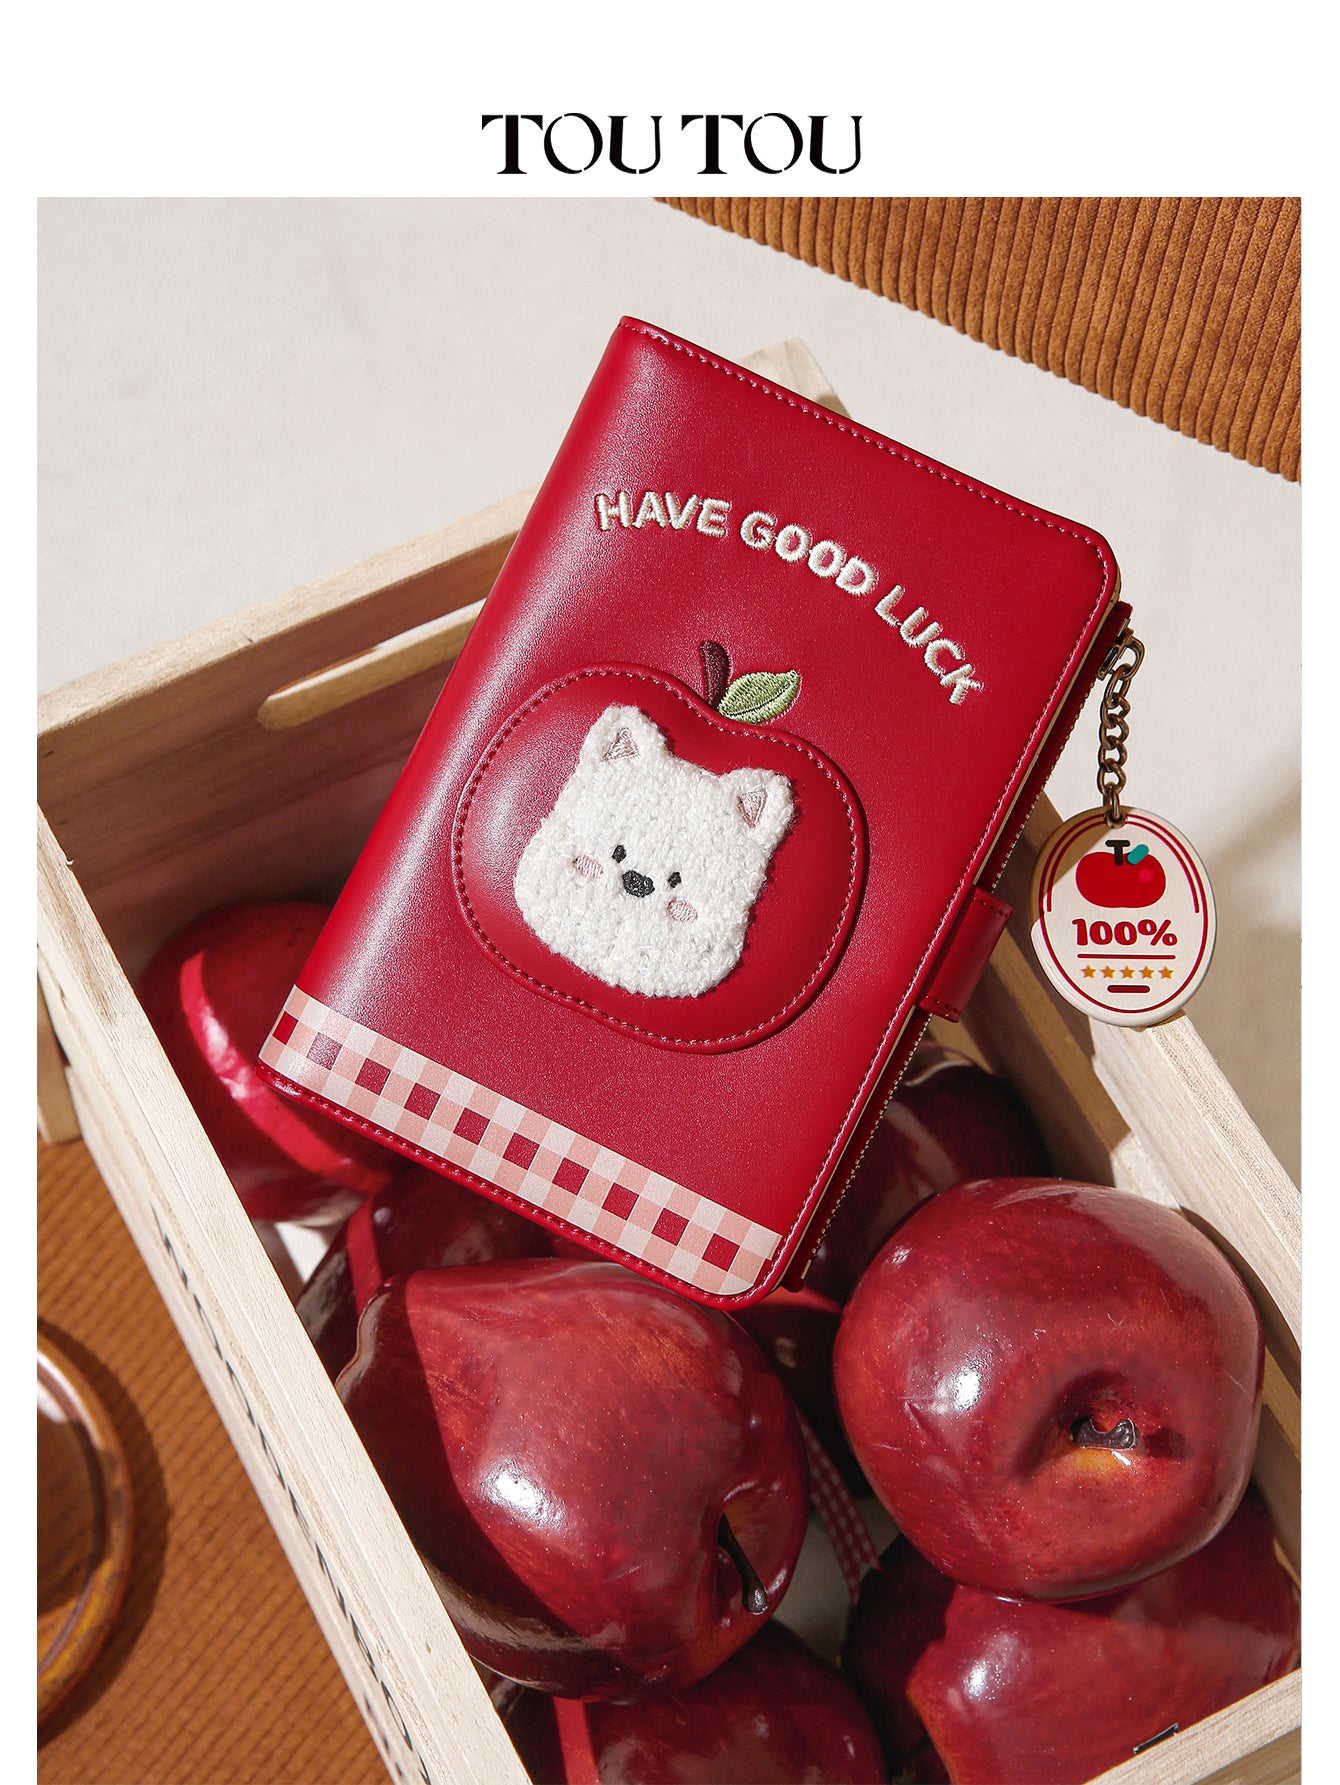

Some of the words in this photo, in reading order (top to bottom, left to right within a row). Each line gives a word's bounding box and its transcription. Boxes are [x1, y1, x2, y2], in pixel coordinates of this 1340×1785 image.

[595, 491, 732, 538] HAVE
[740, 511, 879, 596] GOOD
[874, 584, 985, 704] LUCK
[1072, 918, 1178, 946] 100%
